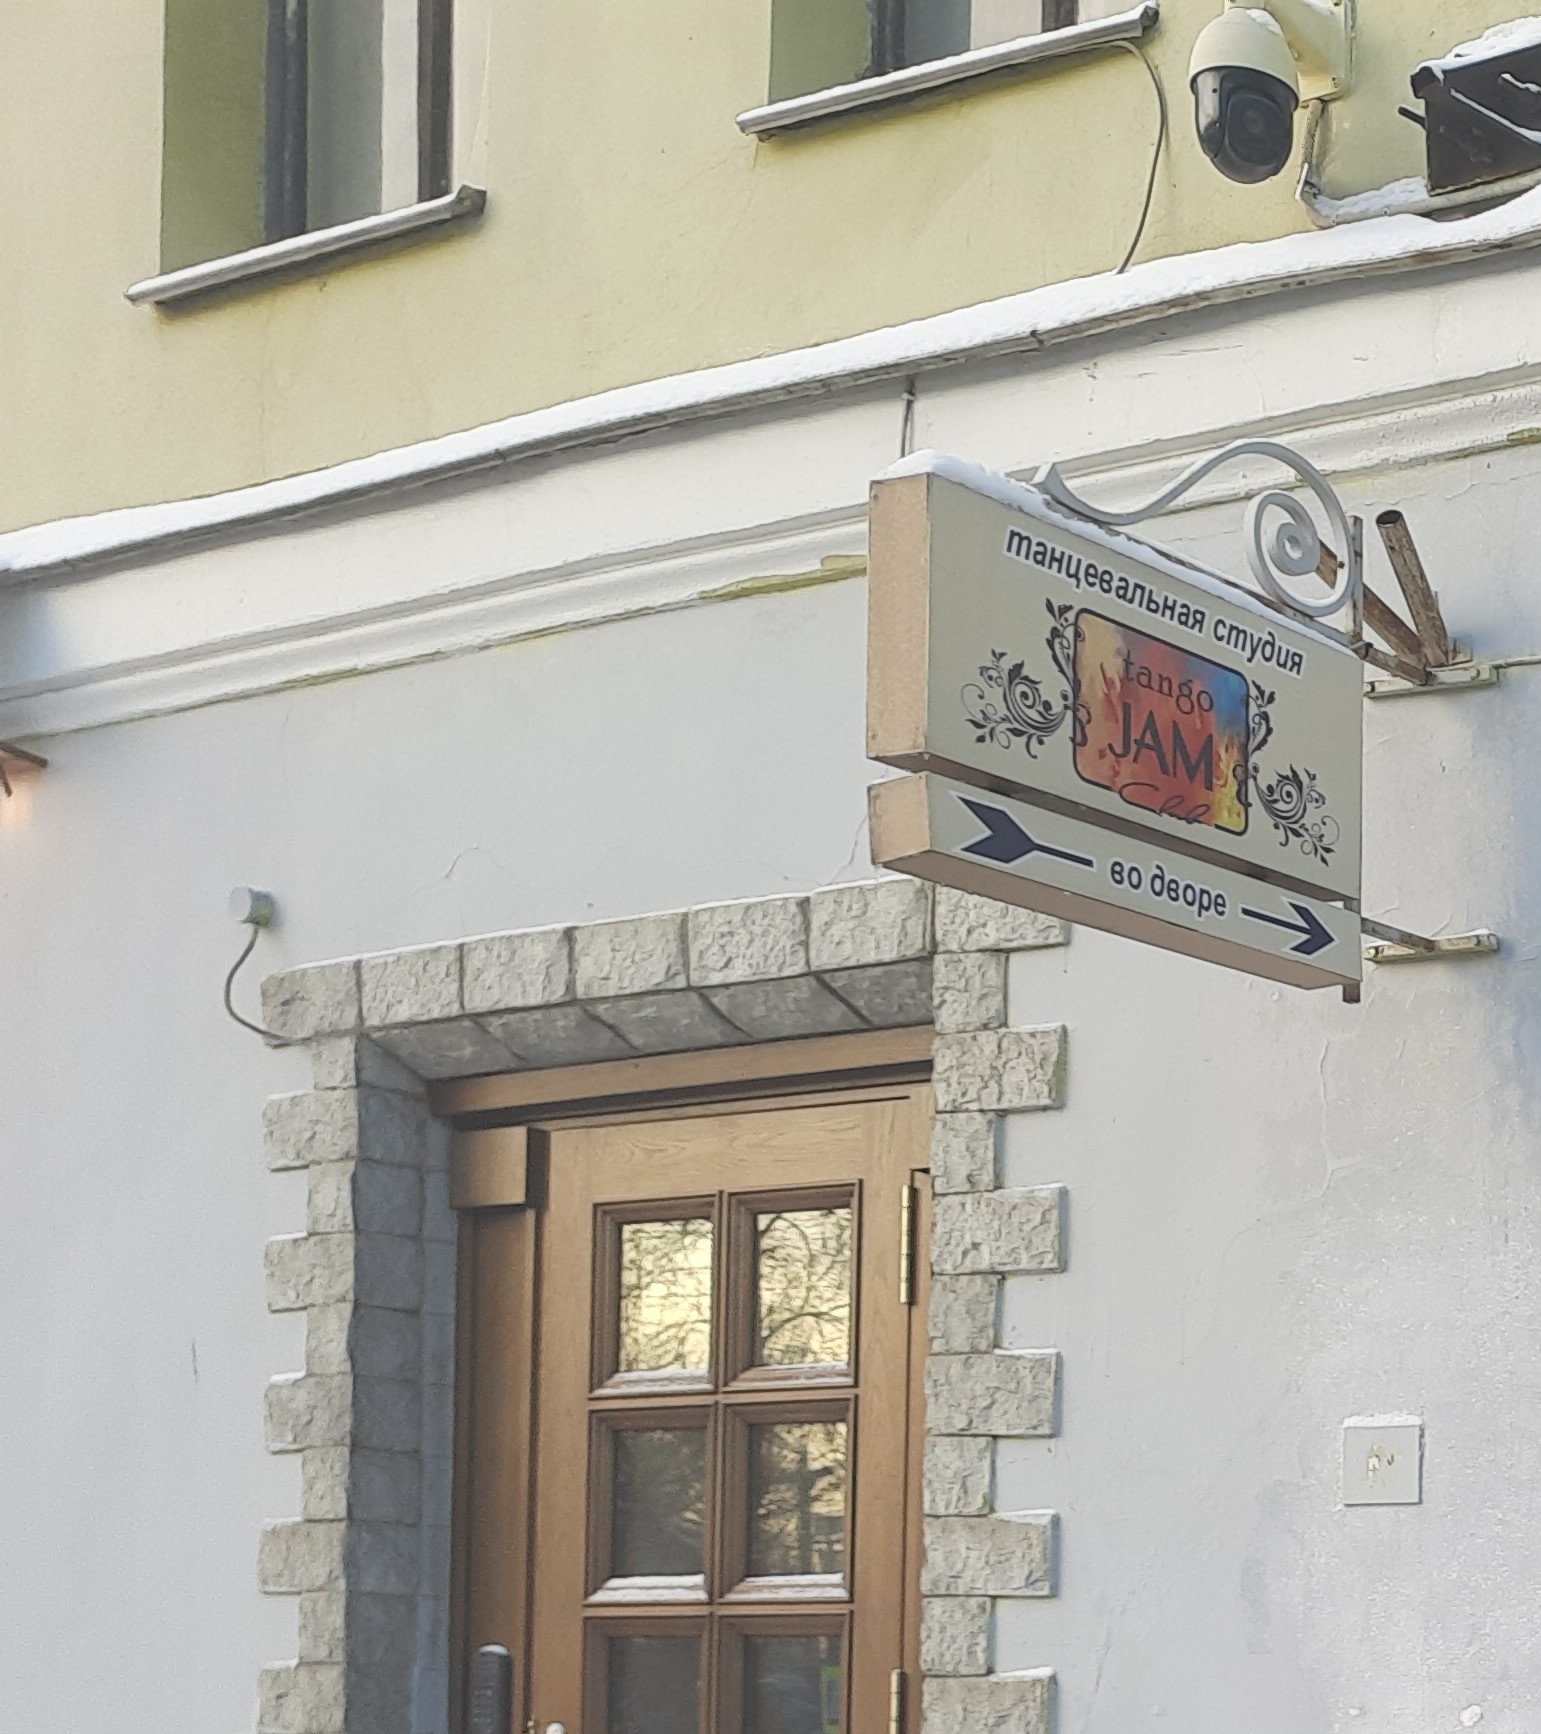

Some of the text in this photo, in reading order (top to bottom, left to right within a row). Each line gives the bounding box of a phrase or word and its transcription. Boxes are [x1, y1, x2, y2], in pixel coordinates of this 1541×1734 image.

[1006, 529, 1304, 676] танцевальная студия
[1122, 649, 1214, 715] tango
[1108, 702, 1213, 792] JAM
[1110, 860, 1227, 917] во дворе
